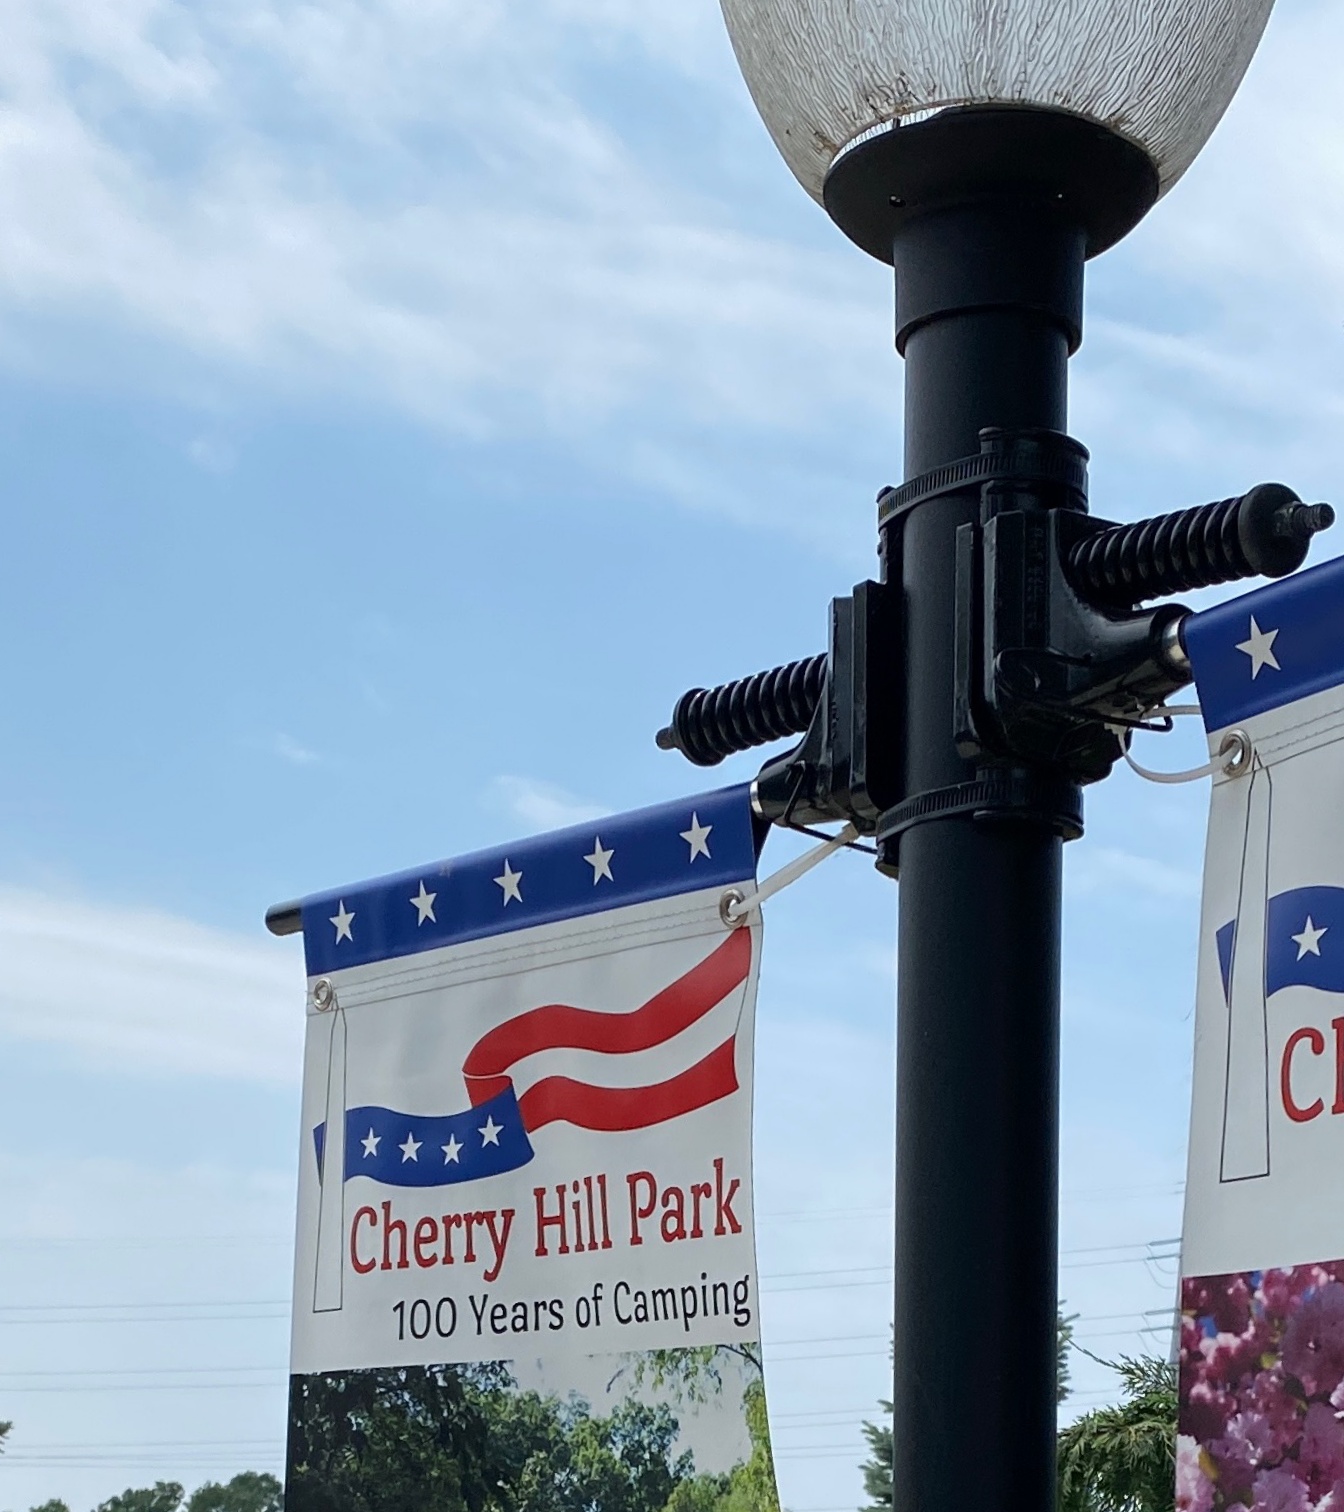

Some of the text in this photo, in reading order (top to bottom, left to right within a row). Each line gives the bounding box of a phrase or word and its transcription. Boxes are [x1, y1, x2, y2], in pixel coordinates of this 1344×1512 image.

[350, 1157, 740, 1280] Cherry Hill Park
[393, 1272, 750, 1340] 100 Years of Camping
